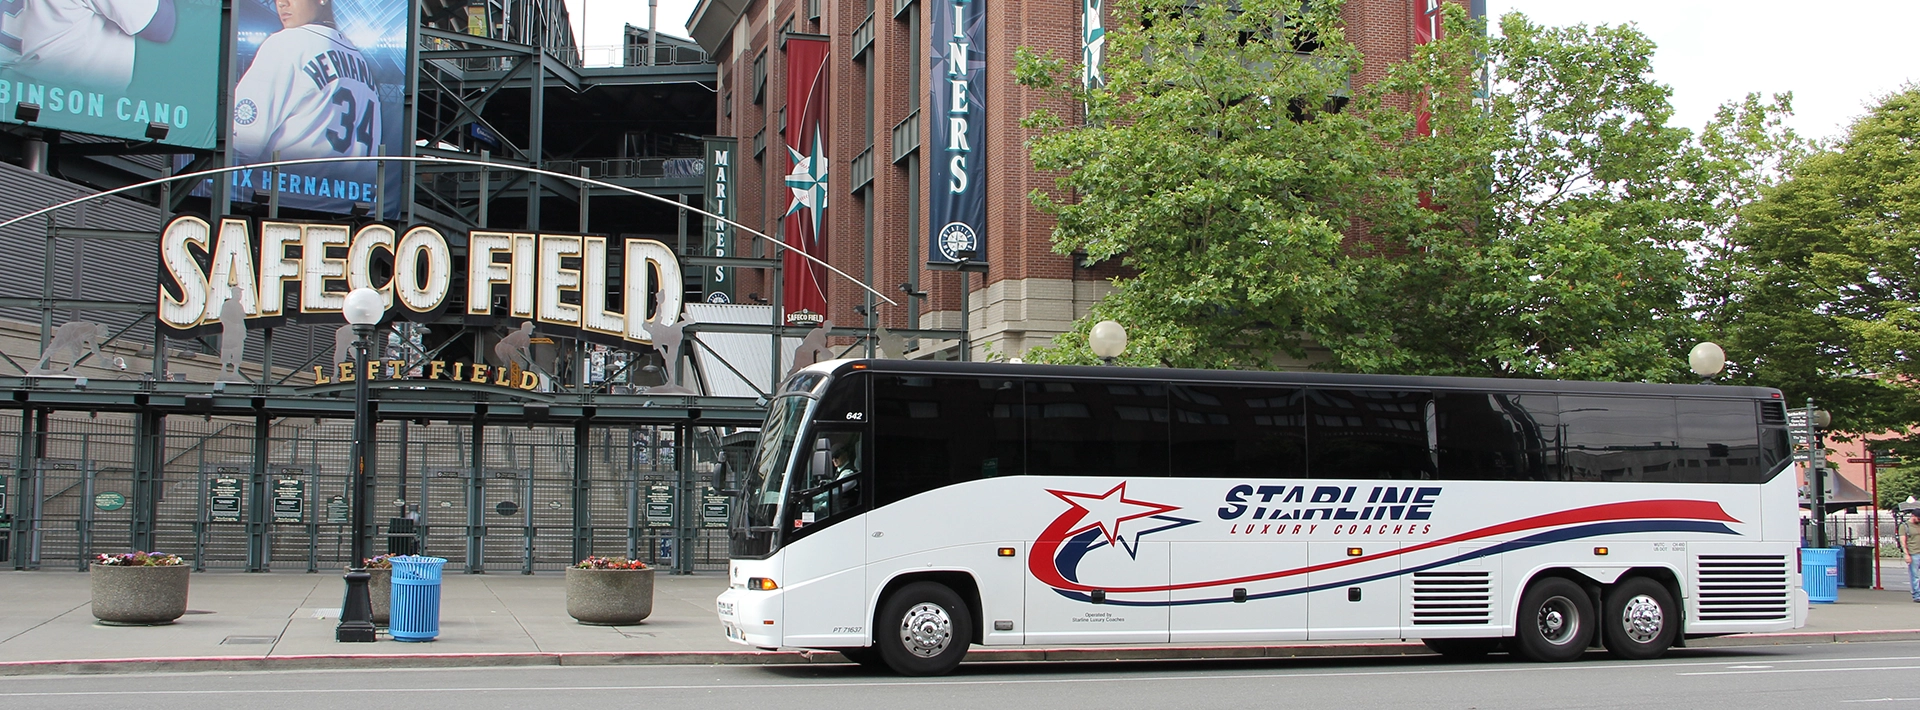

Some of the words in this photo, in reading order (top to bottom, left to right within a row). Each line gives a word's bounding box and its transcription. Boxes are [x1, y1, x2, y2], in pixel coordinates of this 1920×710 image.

[302, 49, 381, 101] HERNAND
[116, 97, 188, 129] CANO
[946, 0, 971, 195] INERS
[325, 86, 375, 159] 34
[262, 170, 378, 203] HERNANDE
[159, 215, 451, 330] SAFECO
[467, 231, 684, 346] FIELD
[787, 313, 807, 323] SAFECO
[808, 314, 824, 323] FIELD
[313, 360, 405, 385] LEFT
[430, 360, 539, 390] FIELD
[846, 412, 863, 420] 642
[1217, 484, 1443, 520] STARLINE
[1230, 524, 1318, 535] LUXURY
[1334, 524, 1432, 535] COACHES
